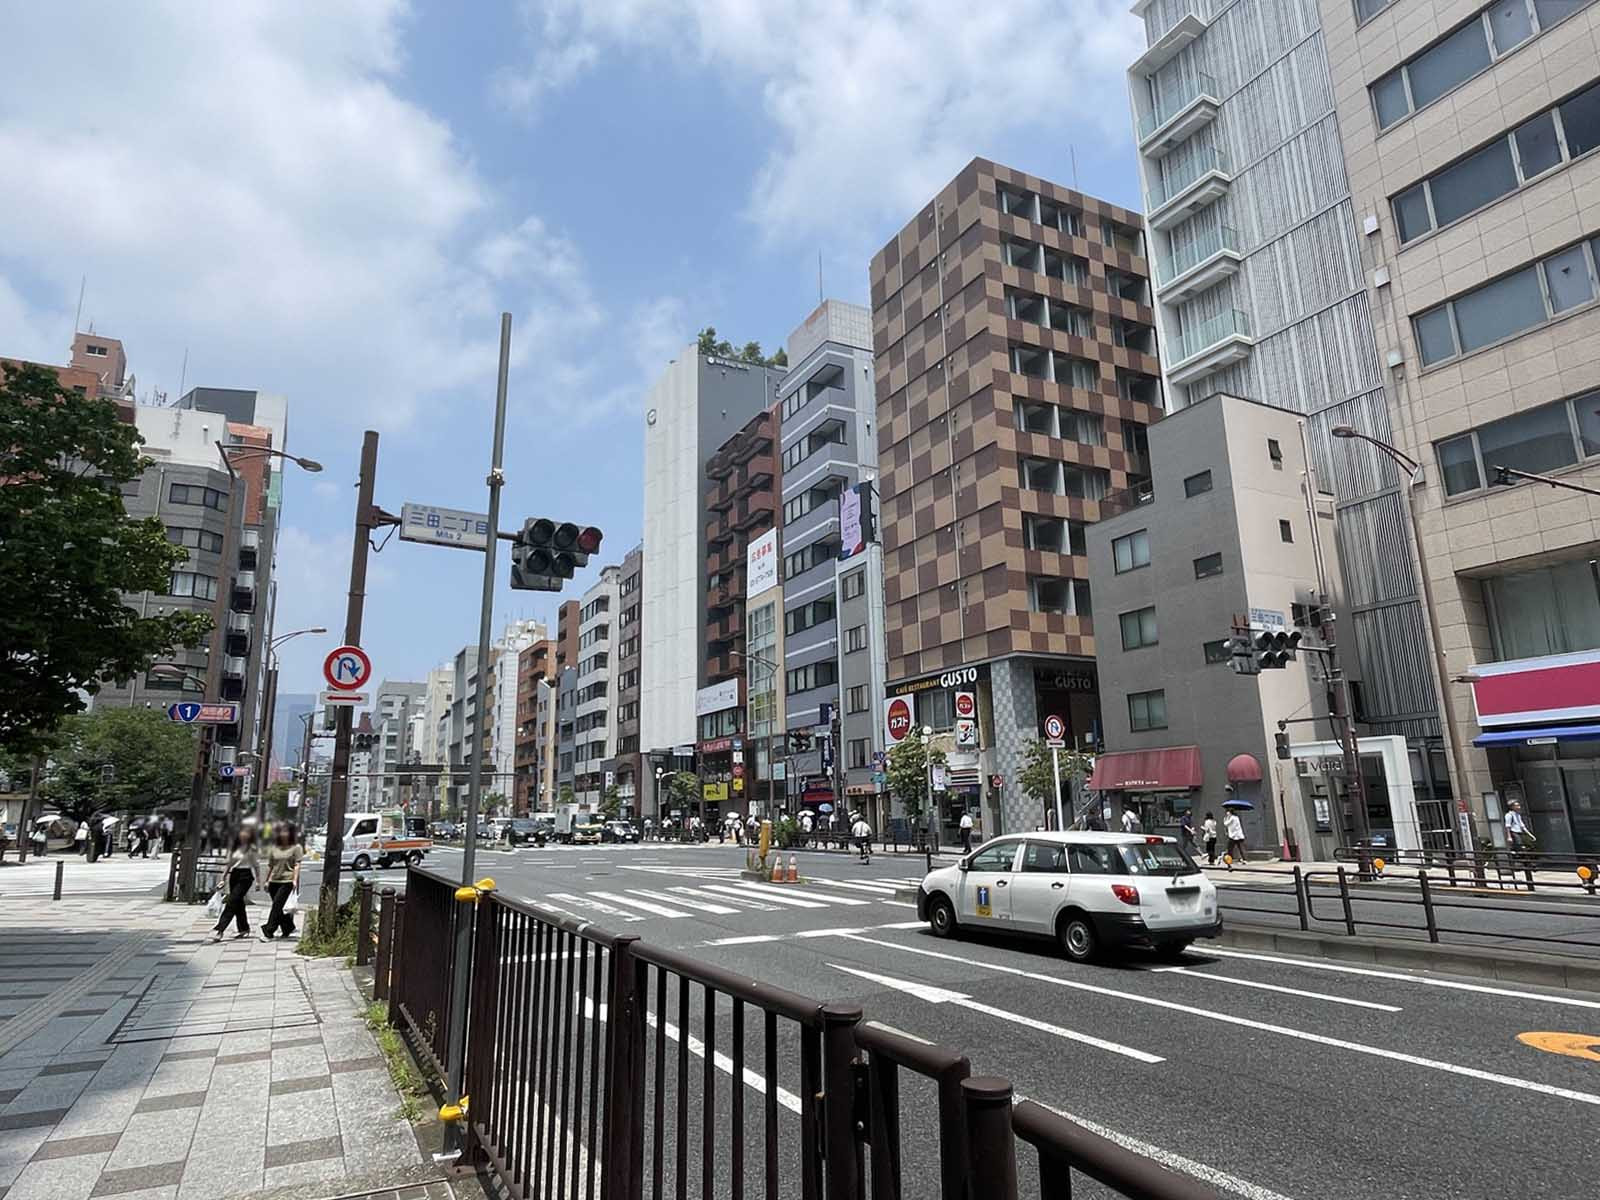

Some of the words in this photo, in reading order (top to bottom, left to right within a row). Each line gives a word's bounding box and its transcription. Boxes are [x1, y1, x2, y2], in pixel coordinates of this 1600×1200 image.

[409, 510, 489, 535] 三田二丁目
[435, 530, 454, 540] Mita
[456, 532, 463, 540] 2
[940, 667, 978, 687] GUSTO
[1055, 675, 1091, 689] GUSTO
[185, 705, 192, 718] 1
[891, 716, 909, 729] ガスト
